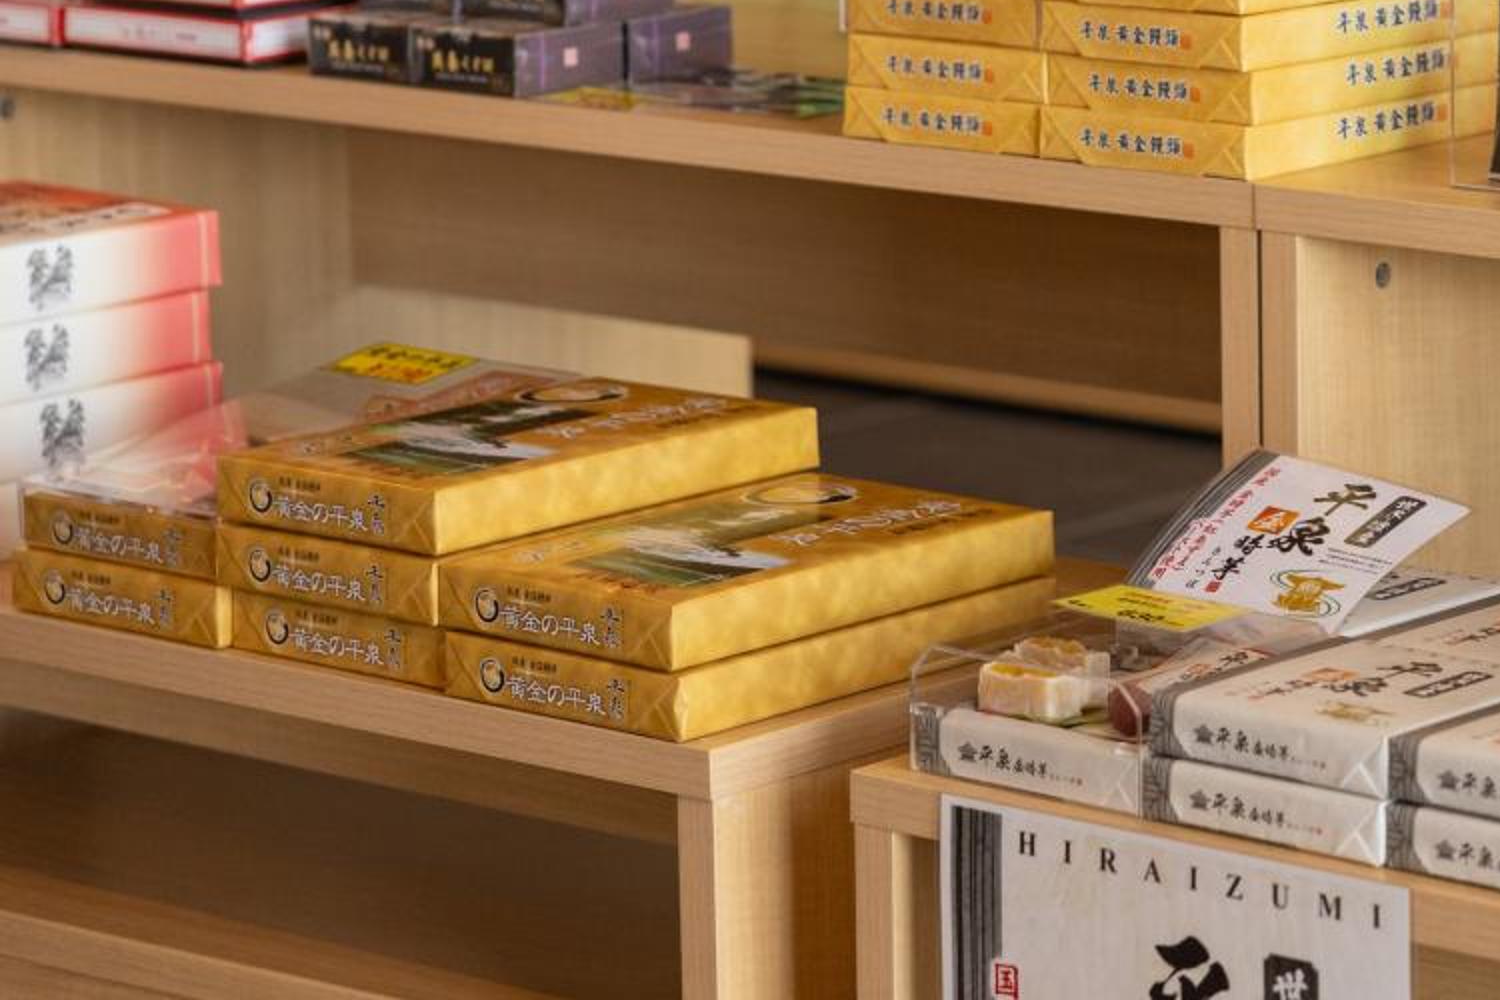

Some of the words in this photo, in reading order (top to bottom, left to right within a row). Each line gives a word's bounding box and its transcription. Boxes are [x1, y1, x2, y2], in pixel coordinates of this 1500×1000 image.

[271, 496, 368, 532] 黄金の平泉
[271, 564, 366, 602] 黄金の平泉
[500, 605, 601, 646] 黄金の平泉
[289, 628, 384, 666] 黄金の平泉
[505, 677, 607, 717] 黄金の平泉
[1018, 830, 1382, 930] HIRAIZUMI
